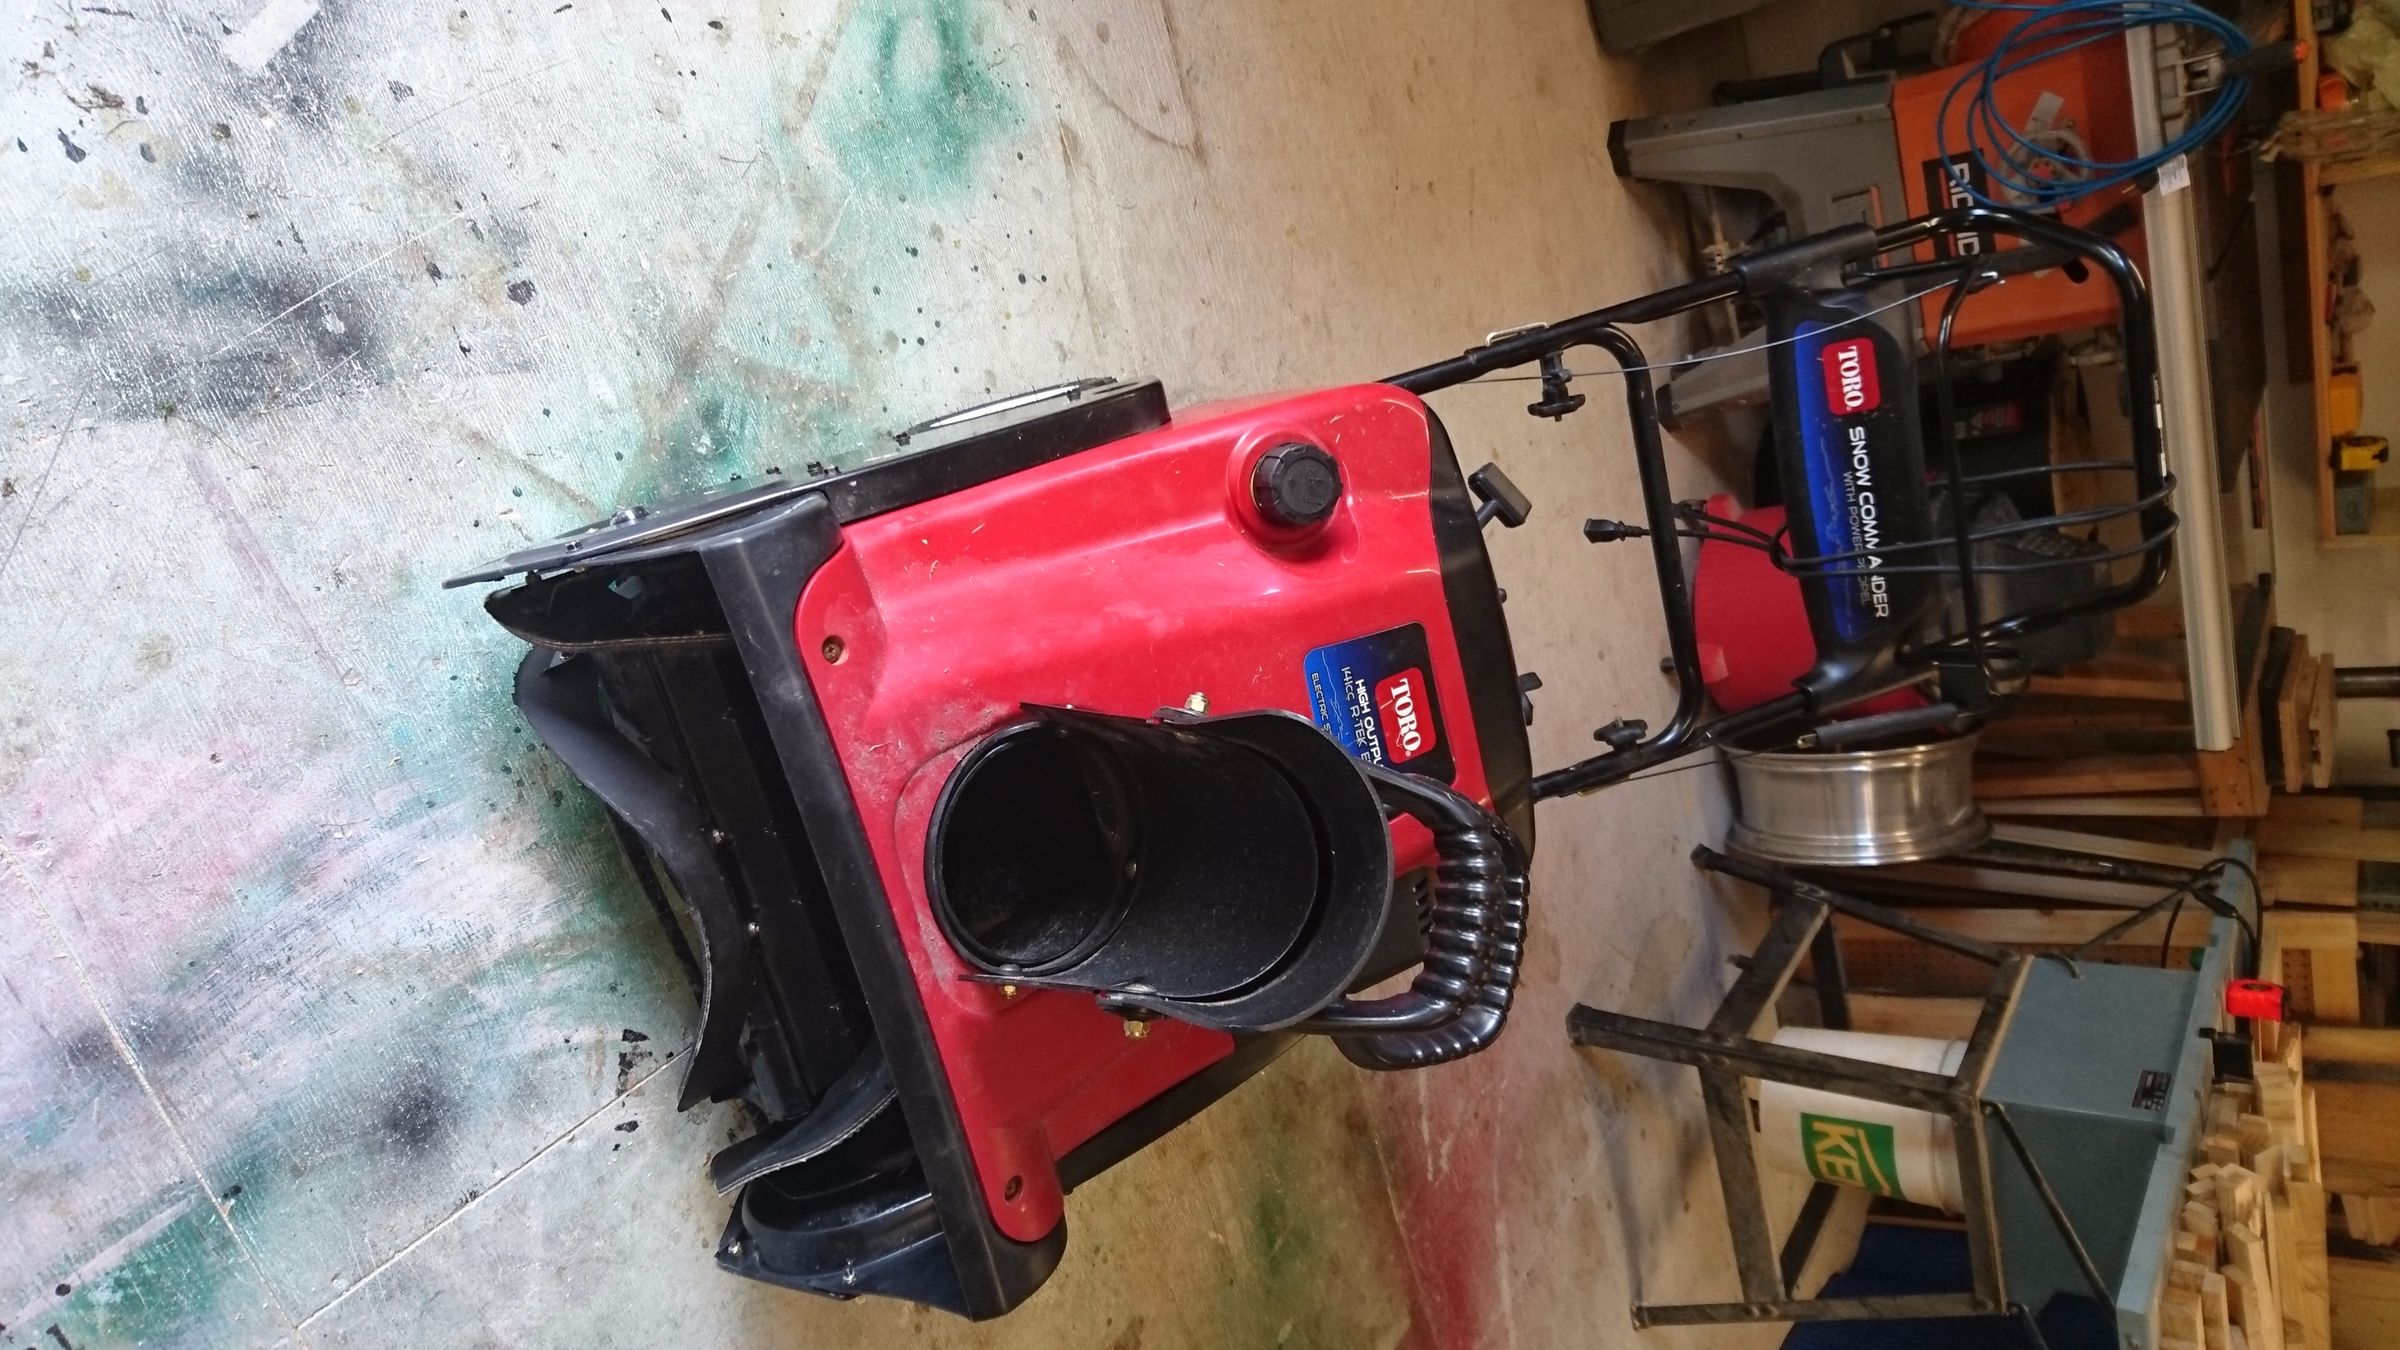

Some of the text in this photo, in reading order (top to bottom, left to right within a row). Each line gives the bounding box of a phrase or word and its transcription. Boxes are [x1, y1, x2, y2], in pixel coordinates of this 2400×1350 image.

[1838, 345, 1865, 409] TORO
[1843, 471, 1857, 502] WITH
[1849, 426, 1872, 486] SNOW
[1311, 672, 1329, 721] ELECTRIC
[1355, 679, 1371, 714] HIGH
[1364, 716, 1384, 767] OUTPU
[1390, 677, 1421, 753] TORO
